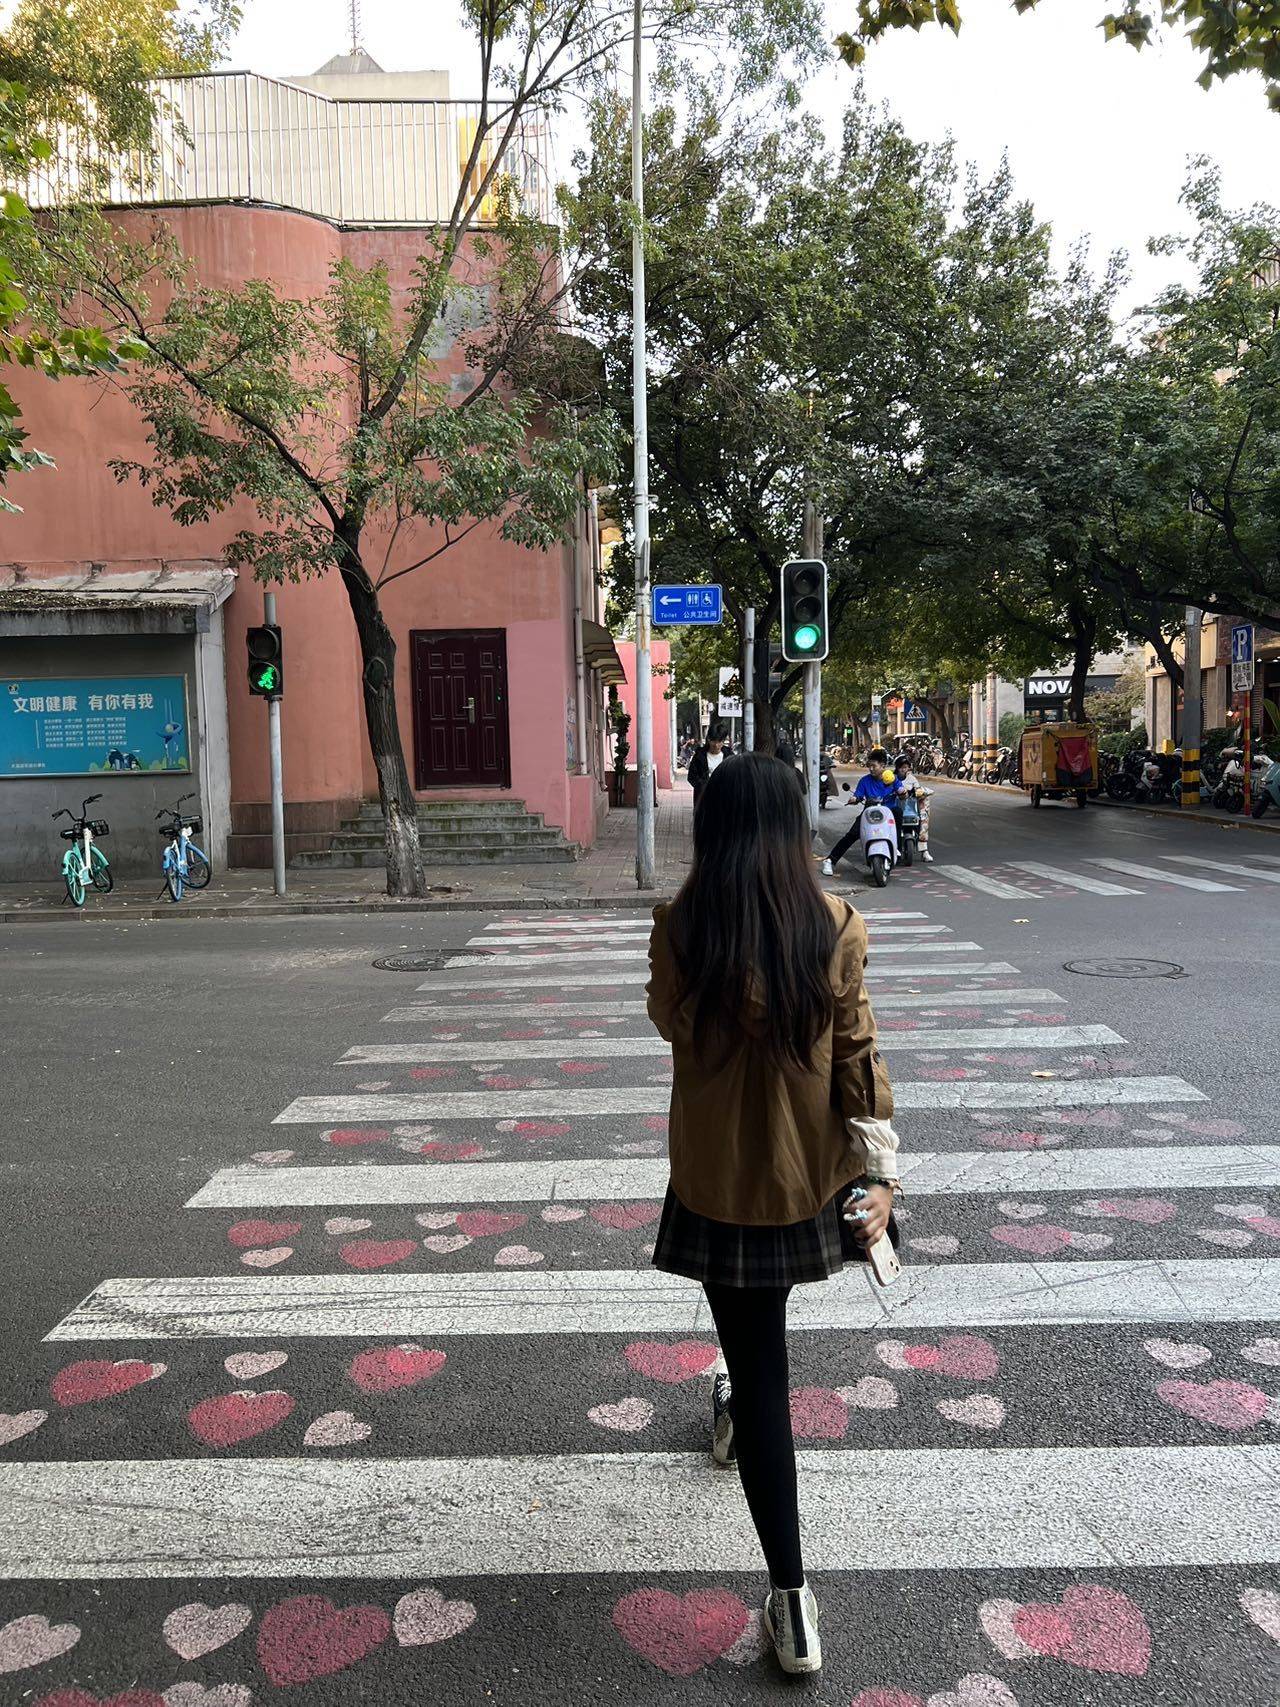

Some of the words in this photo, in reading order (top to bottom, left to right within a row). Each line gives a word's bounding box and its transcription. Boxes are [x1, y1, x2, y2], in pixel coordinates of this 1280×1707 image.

[683, 611, 717, 619] 公共卫生间
[1236, 629, 1248, 660] P
[1029, 680, 1072, 695] NOV
[13, 695, 78, 713] 文明健康
[88, 693, 154, 711] 有你有我
